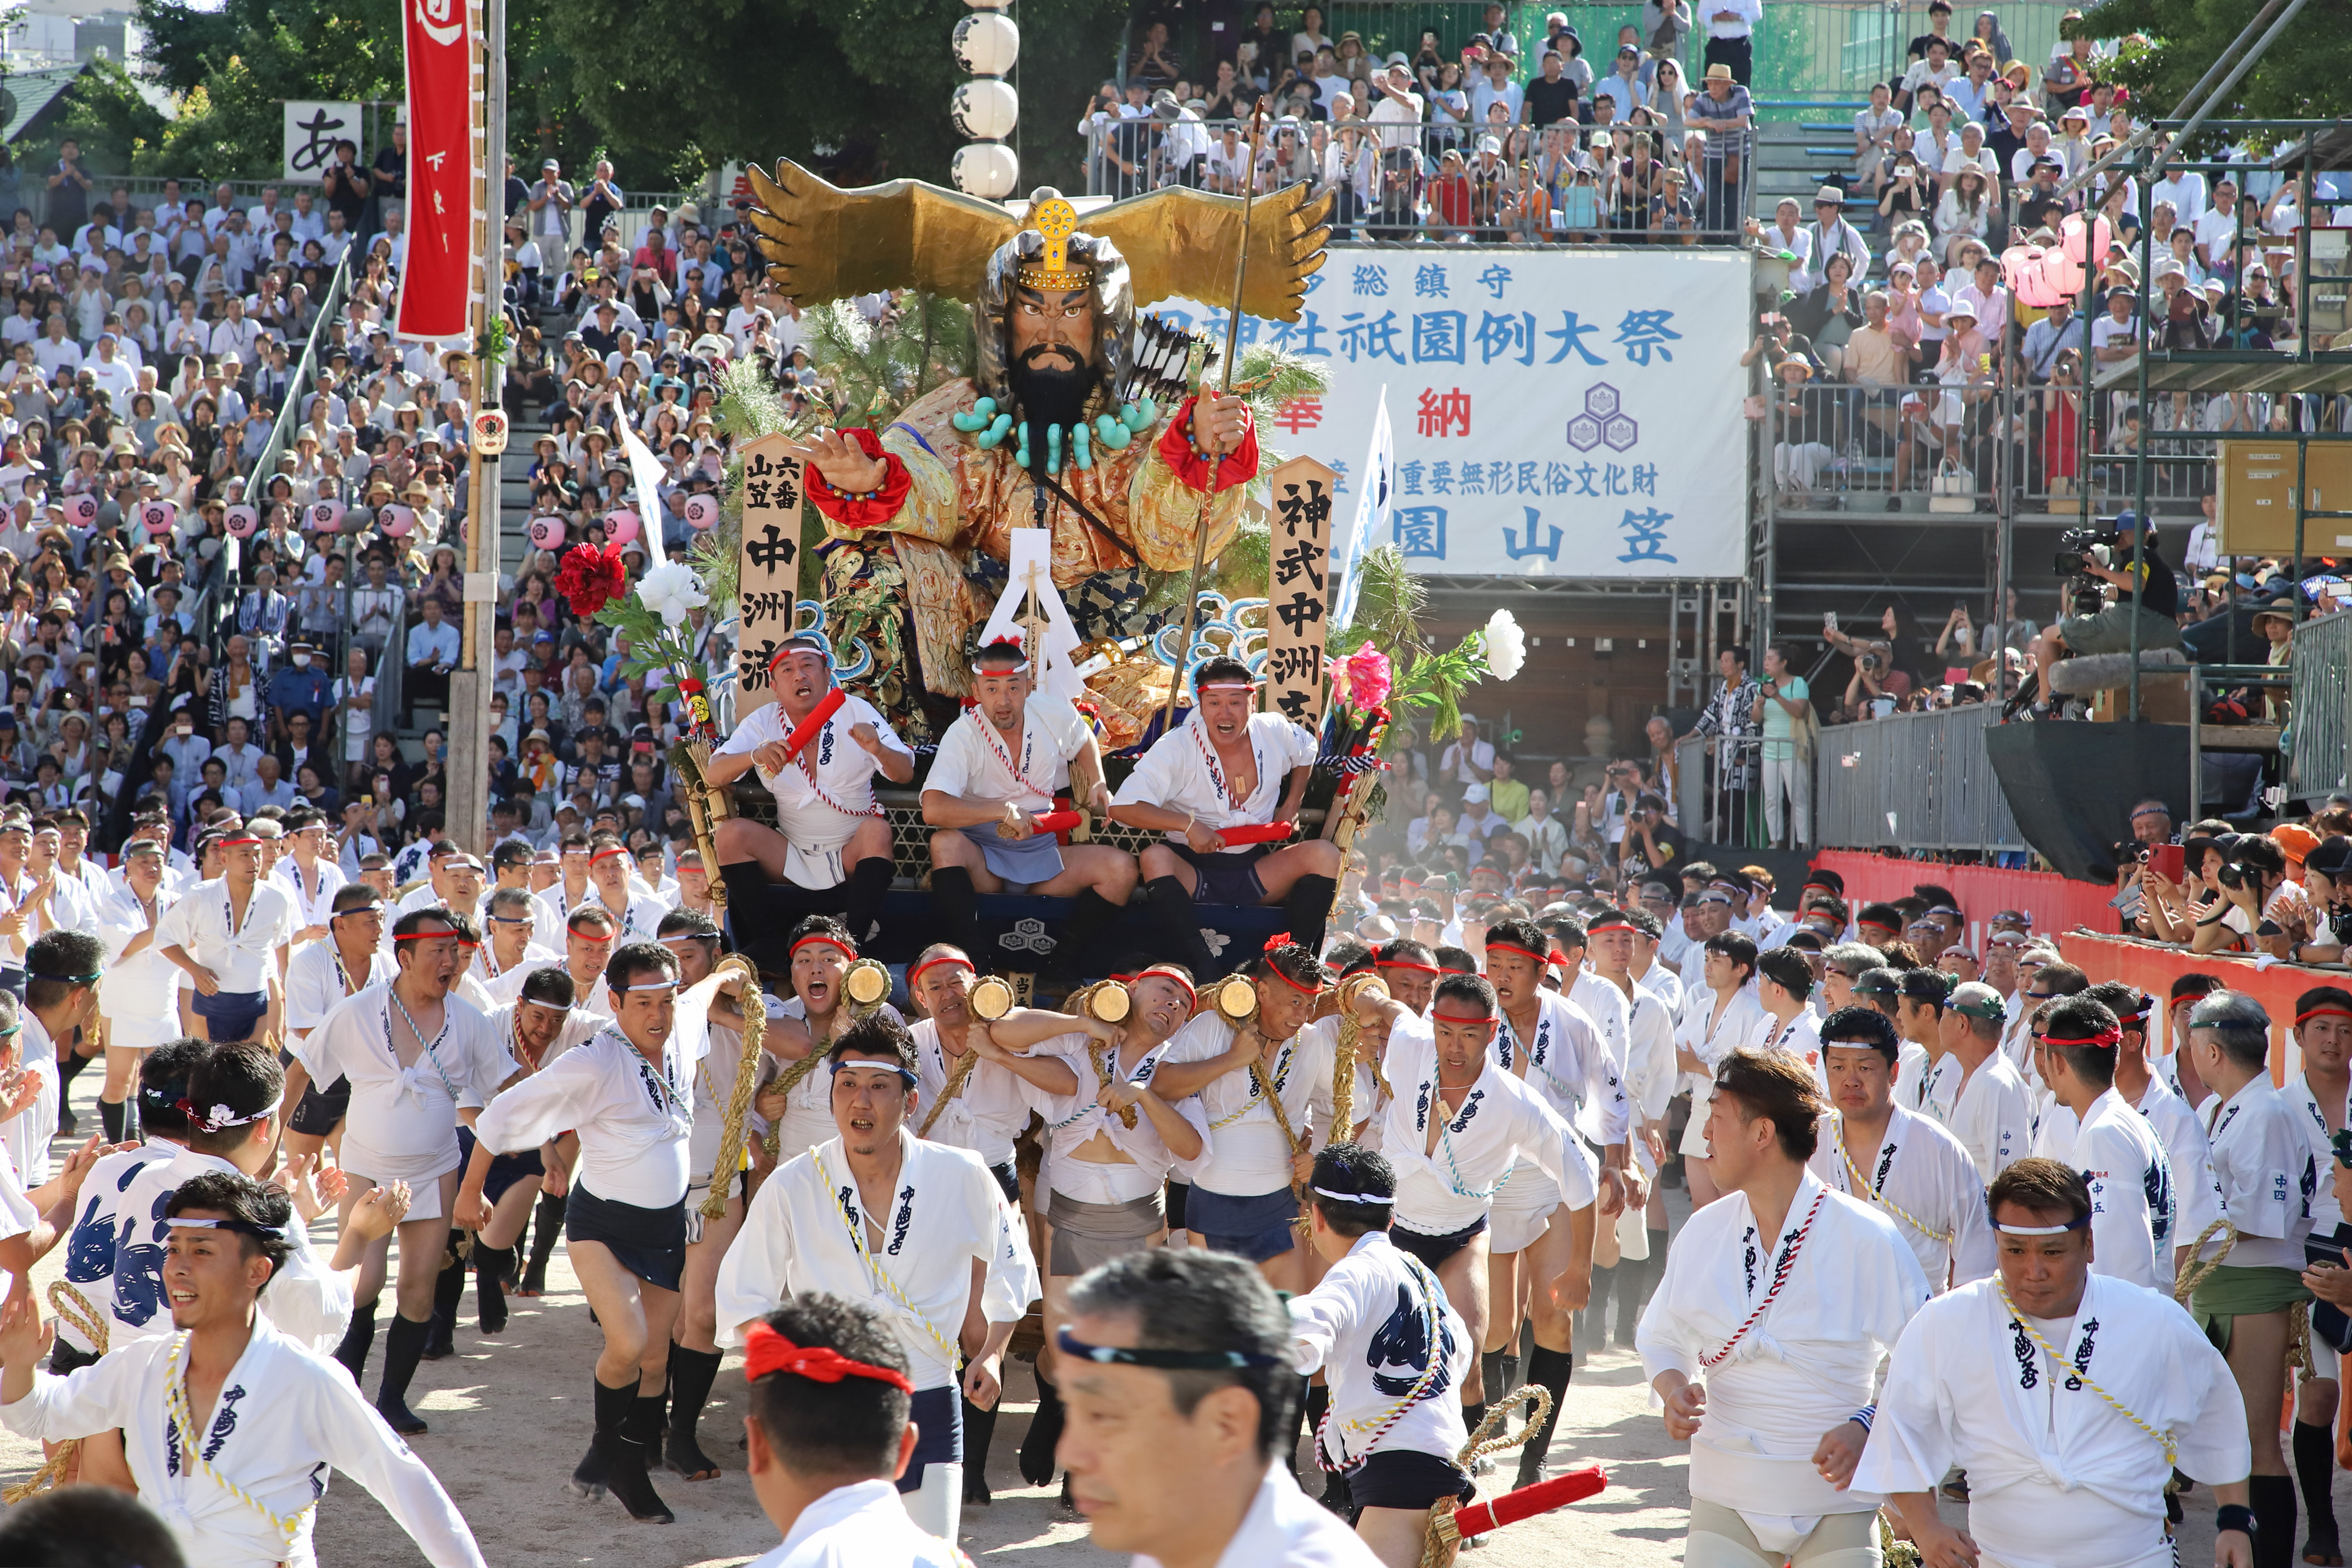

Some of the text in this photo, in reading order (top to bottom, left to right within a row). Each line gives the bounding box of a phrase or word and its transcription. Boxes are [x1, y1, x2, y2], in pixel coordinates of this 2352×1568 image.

[292, 109, 345, 171] あ
[485, 421, 497, 435] 東
[747, 454, 773, 509] 山笠
[772, 456, 800, 510] 六番
[1331, 505, 1677, 564] 園山笠
[2000, 1131, 2011, 1156] 中四
[2092, 1182, 2105, 1214] 中五
[2274, 1174, 2287, 1201] 中四
